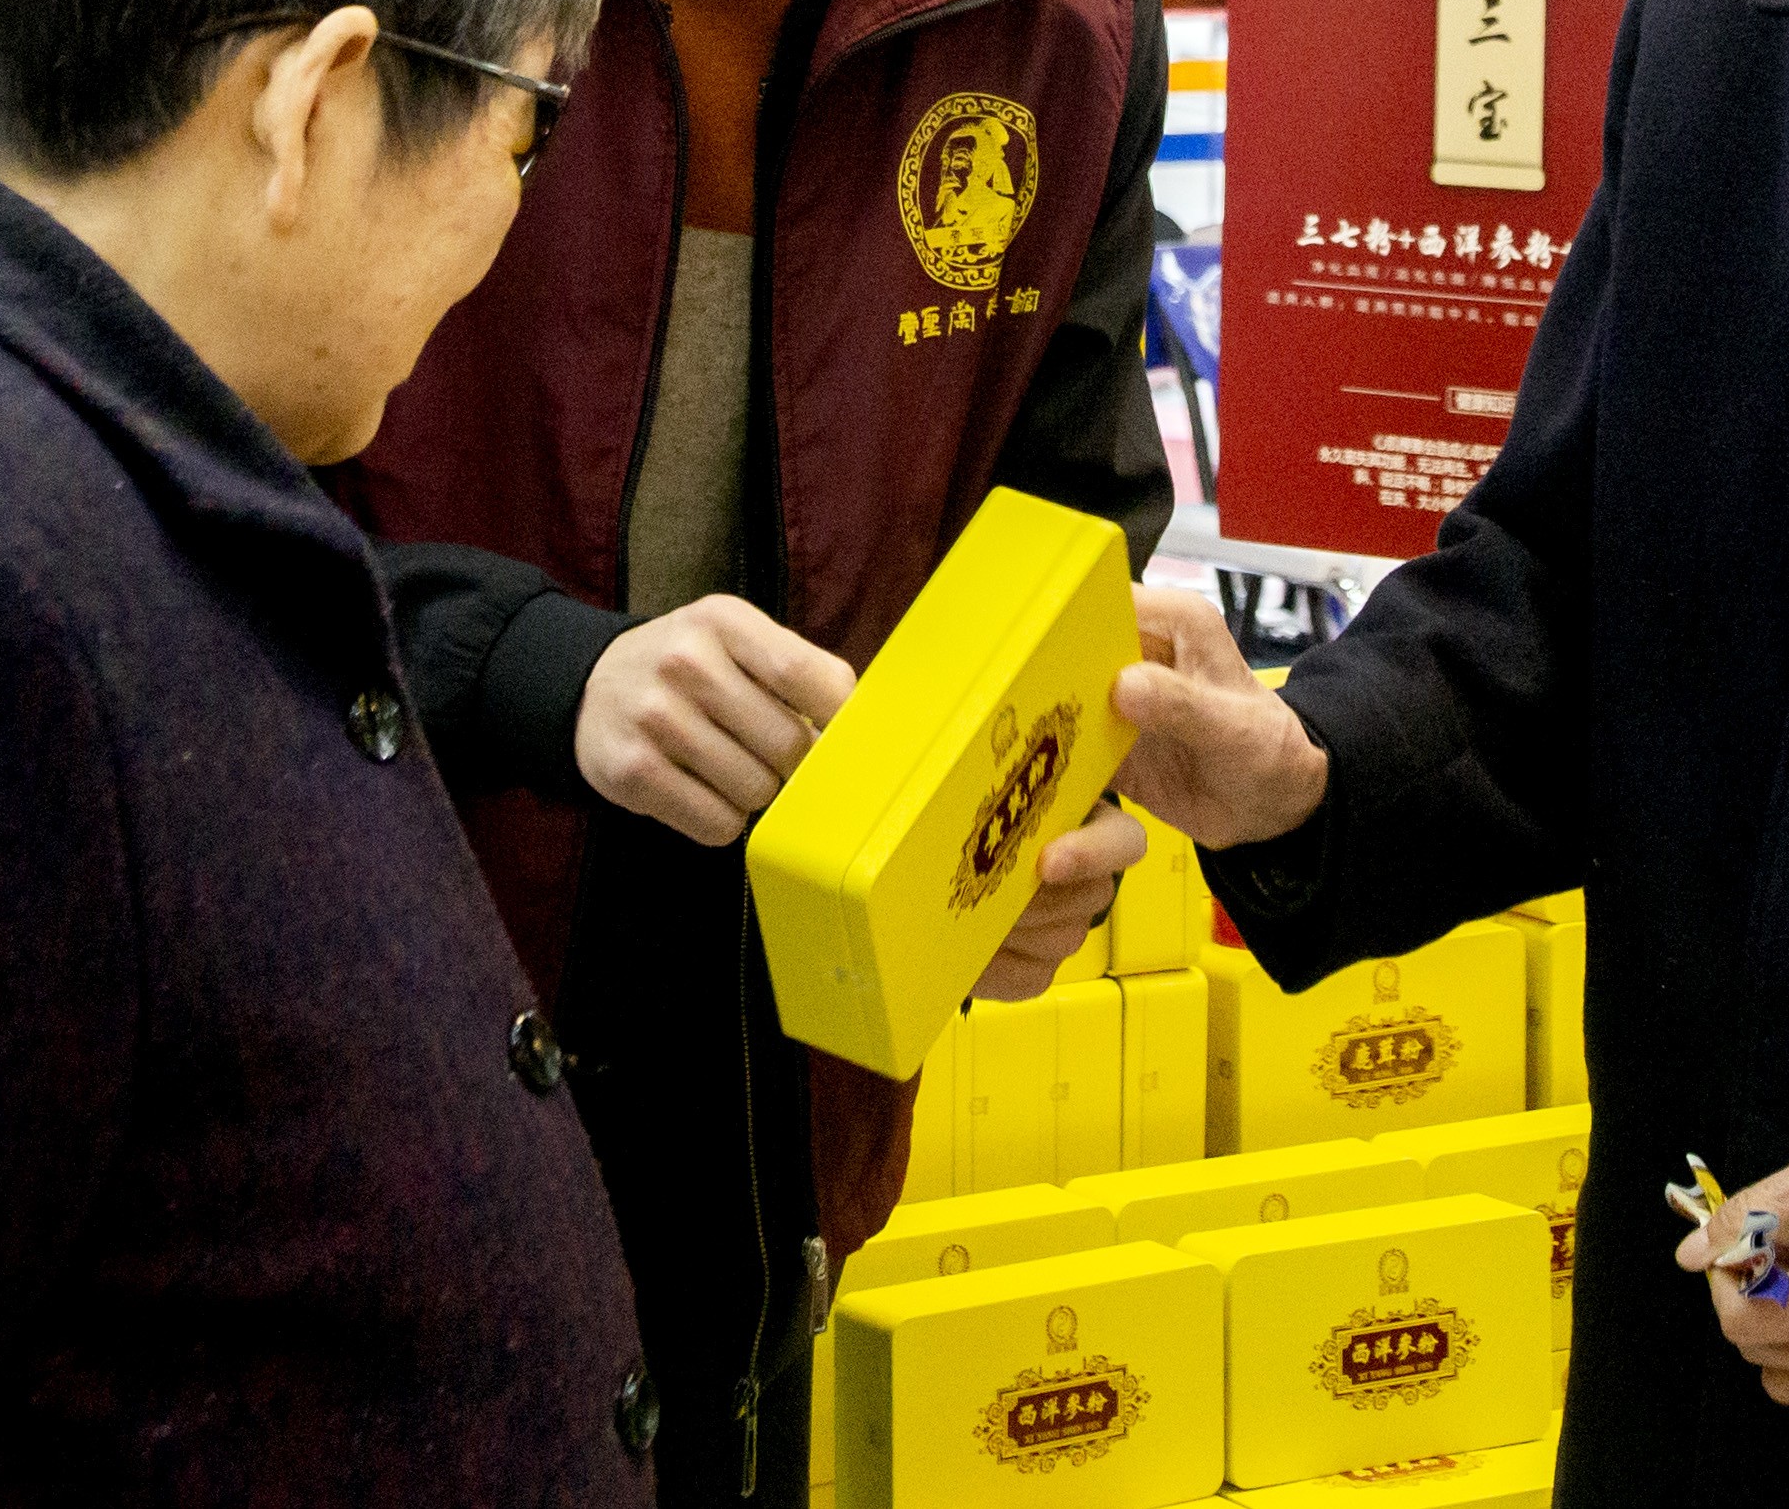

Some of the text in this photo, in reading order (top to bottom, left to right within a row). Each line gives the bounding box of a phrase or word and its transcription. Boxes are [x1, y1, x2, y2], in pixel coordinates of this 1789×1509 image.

[1351, 1331, 1439, 1364] 西洋参粉
[1017, 1390, 1109, 1428] 西洋参粉
